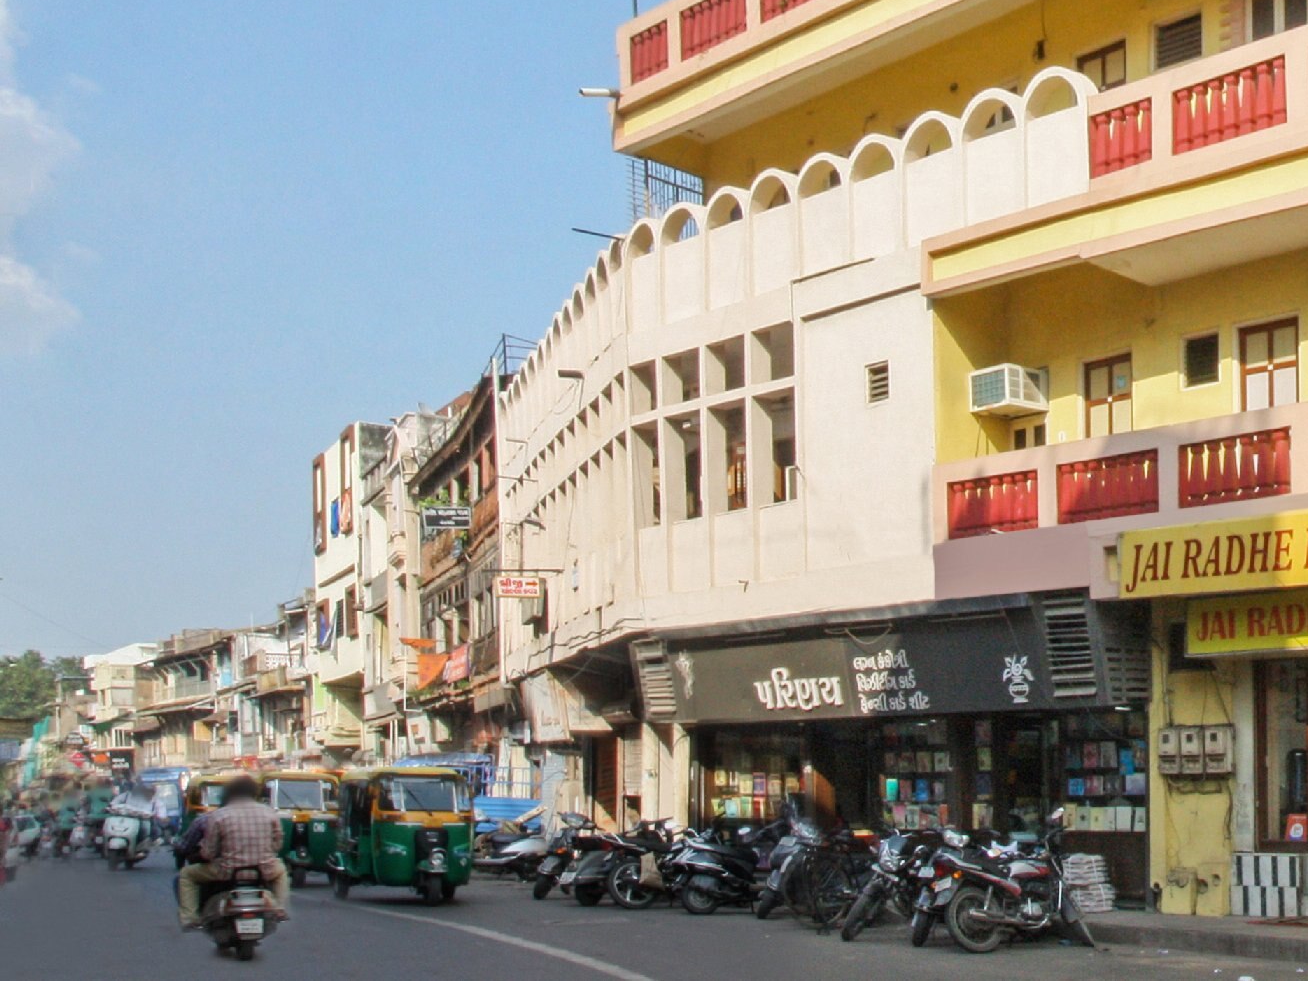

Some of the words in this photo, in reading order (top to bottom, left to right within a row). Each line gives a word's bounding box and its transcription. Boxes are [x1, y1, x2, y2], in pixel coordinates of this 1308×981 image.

[1125, 540, 1173, 593] JAI
[1181, 529, 1293, 579] RADHE
[1196, 608, 1236, 641] JAI
